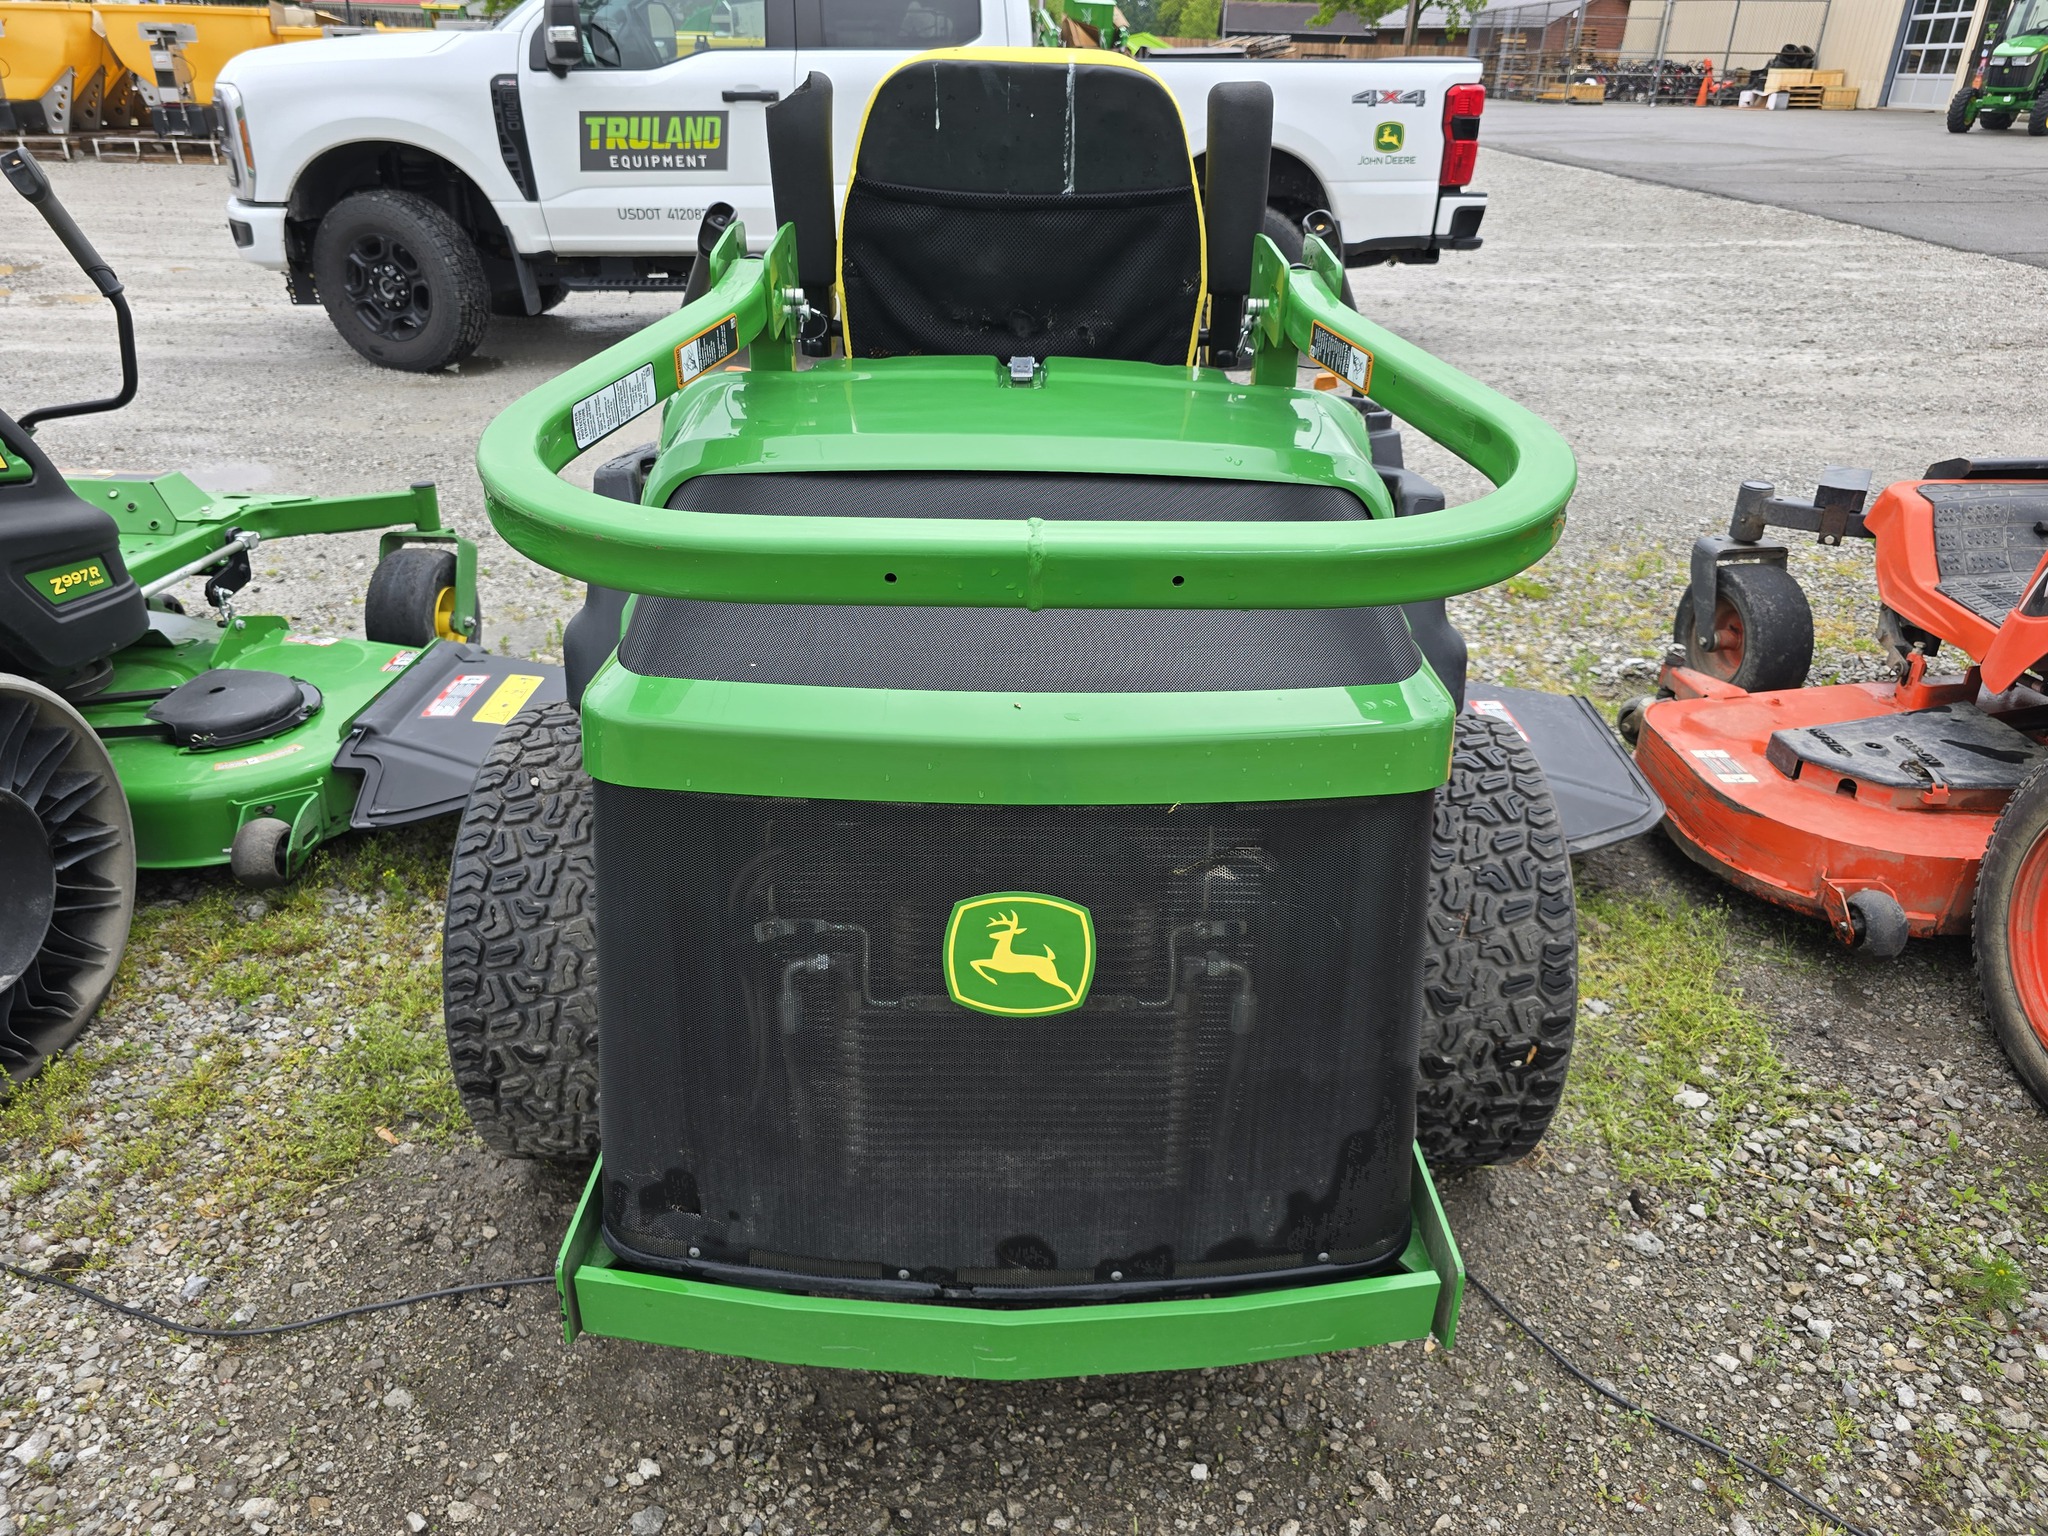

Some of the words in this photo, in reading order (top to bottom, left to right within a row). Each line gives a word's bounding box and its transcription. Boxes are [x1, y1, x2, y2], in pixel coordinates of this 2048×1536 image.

[585, 116, 722, 150] TRULAND
[609, 155, 707, 169] EQUIPMENT
[1357, 155, 1383, 165] JOHN
[1385, 155, 1416, 165] DEERE
[618, 208, 662, 220] USDOT
[667, 208, 706, 220] 41208
